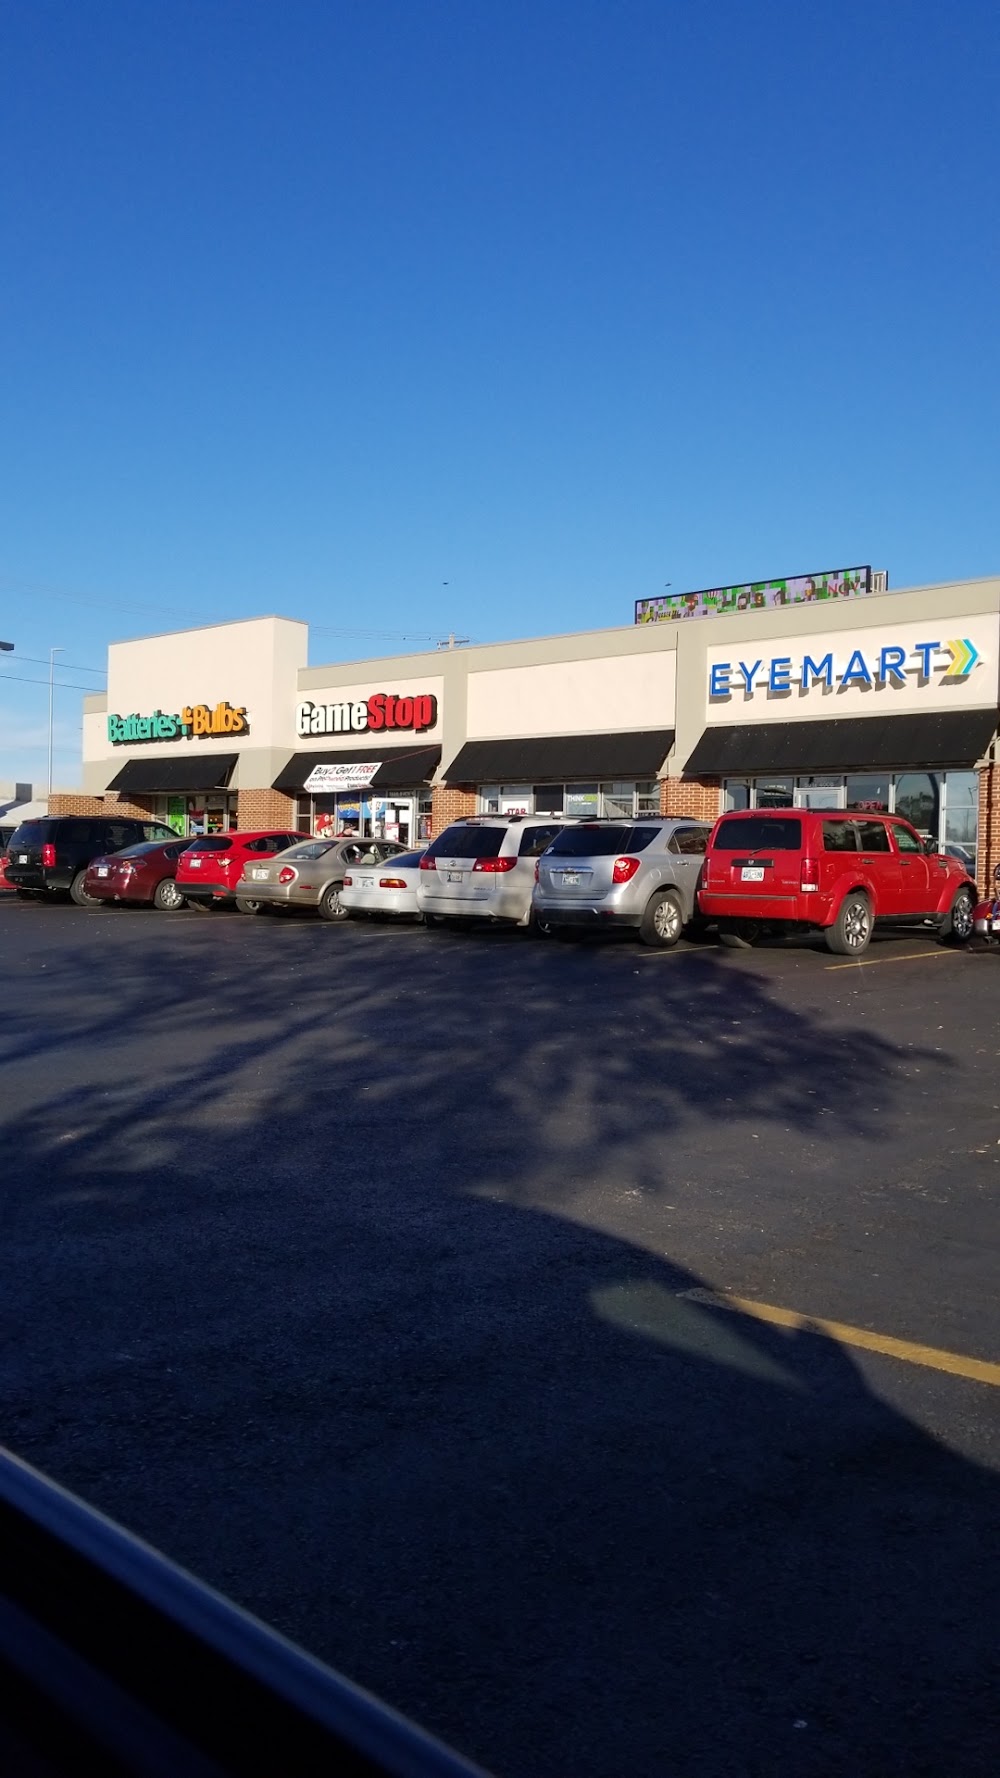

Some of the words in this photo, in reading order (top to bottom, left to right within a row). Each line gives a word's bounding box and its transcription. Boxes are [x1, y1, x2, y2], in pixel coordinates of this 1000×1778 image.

[709, 641, 942, 696] EYEMART
[107, 710, 177, 742] Batteries
[192, 702, 245, 735] Bulbs
[295, 693, 433, 735] GameStop
[314, 766, 329, 775] Buy
[336, 766, 352, 775] Get
[357, 765, 378, 774] FREE
[504, 808, 527, 816] STAR
[859, 800, 884, 810] OPEN
